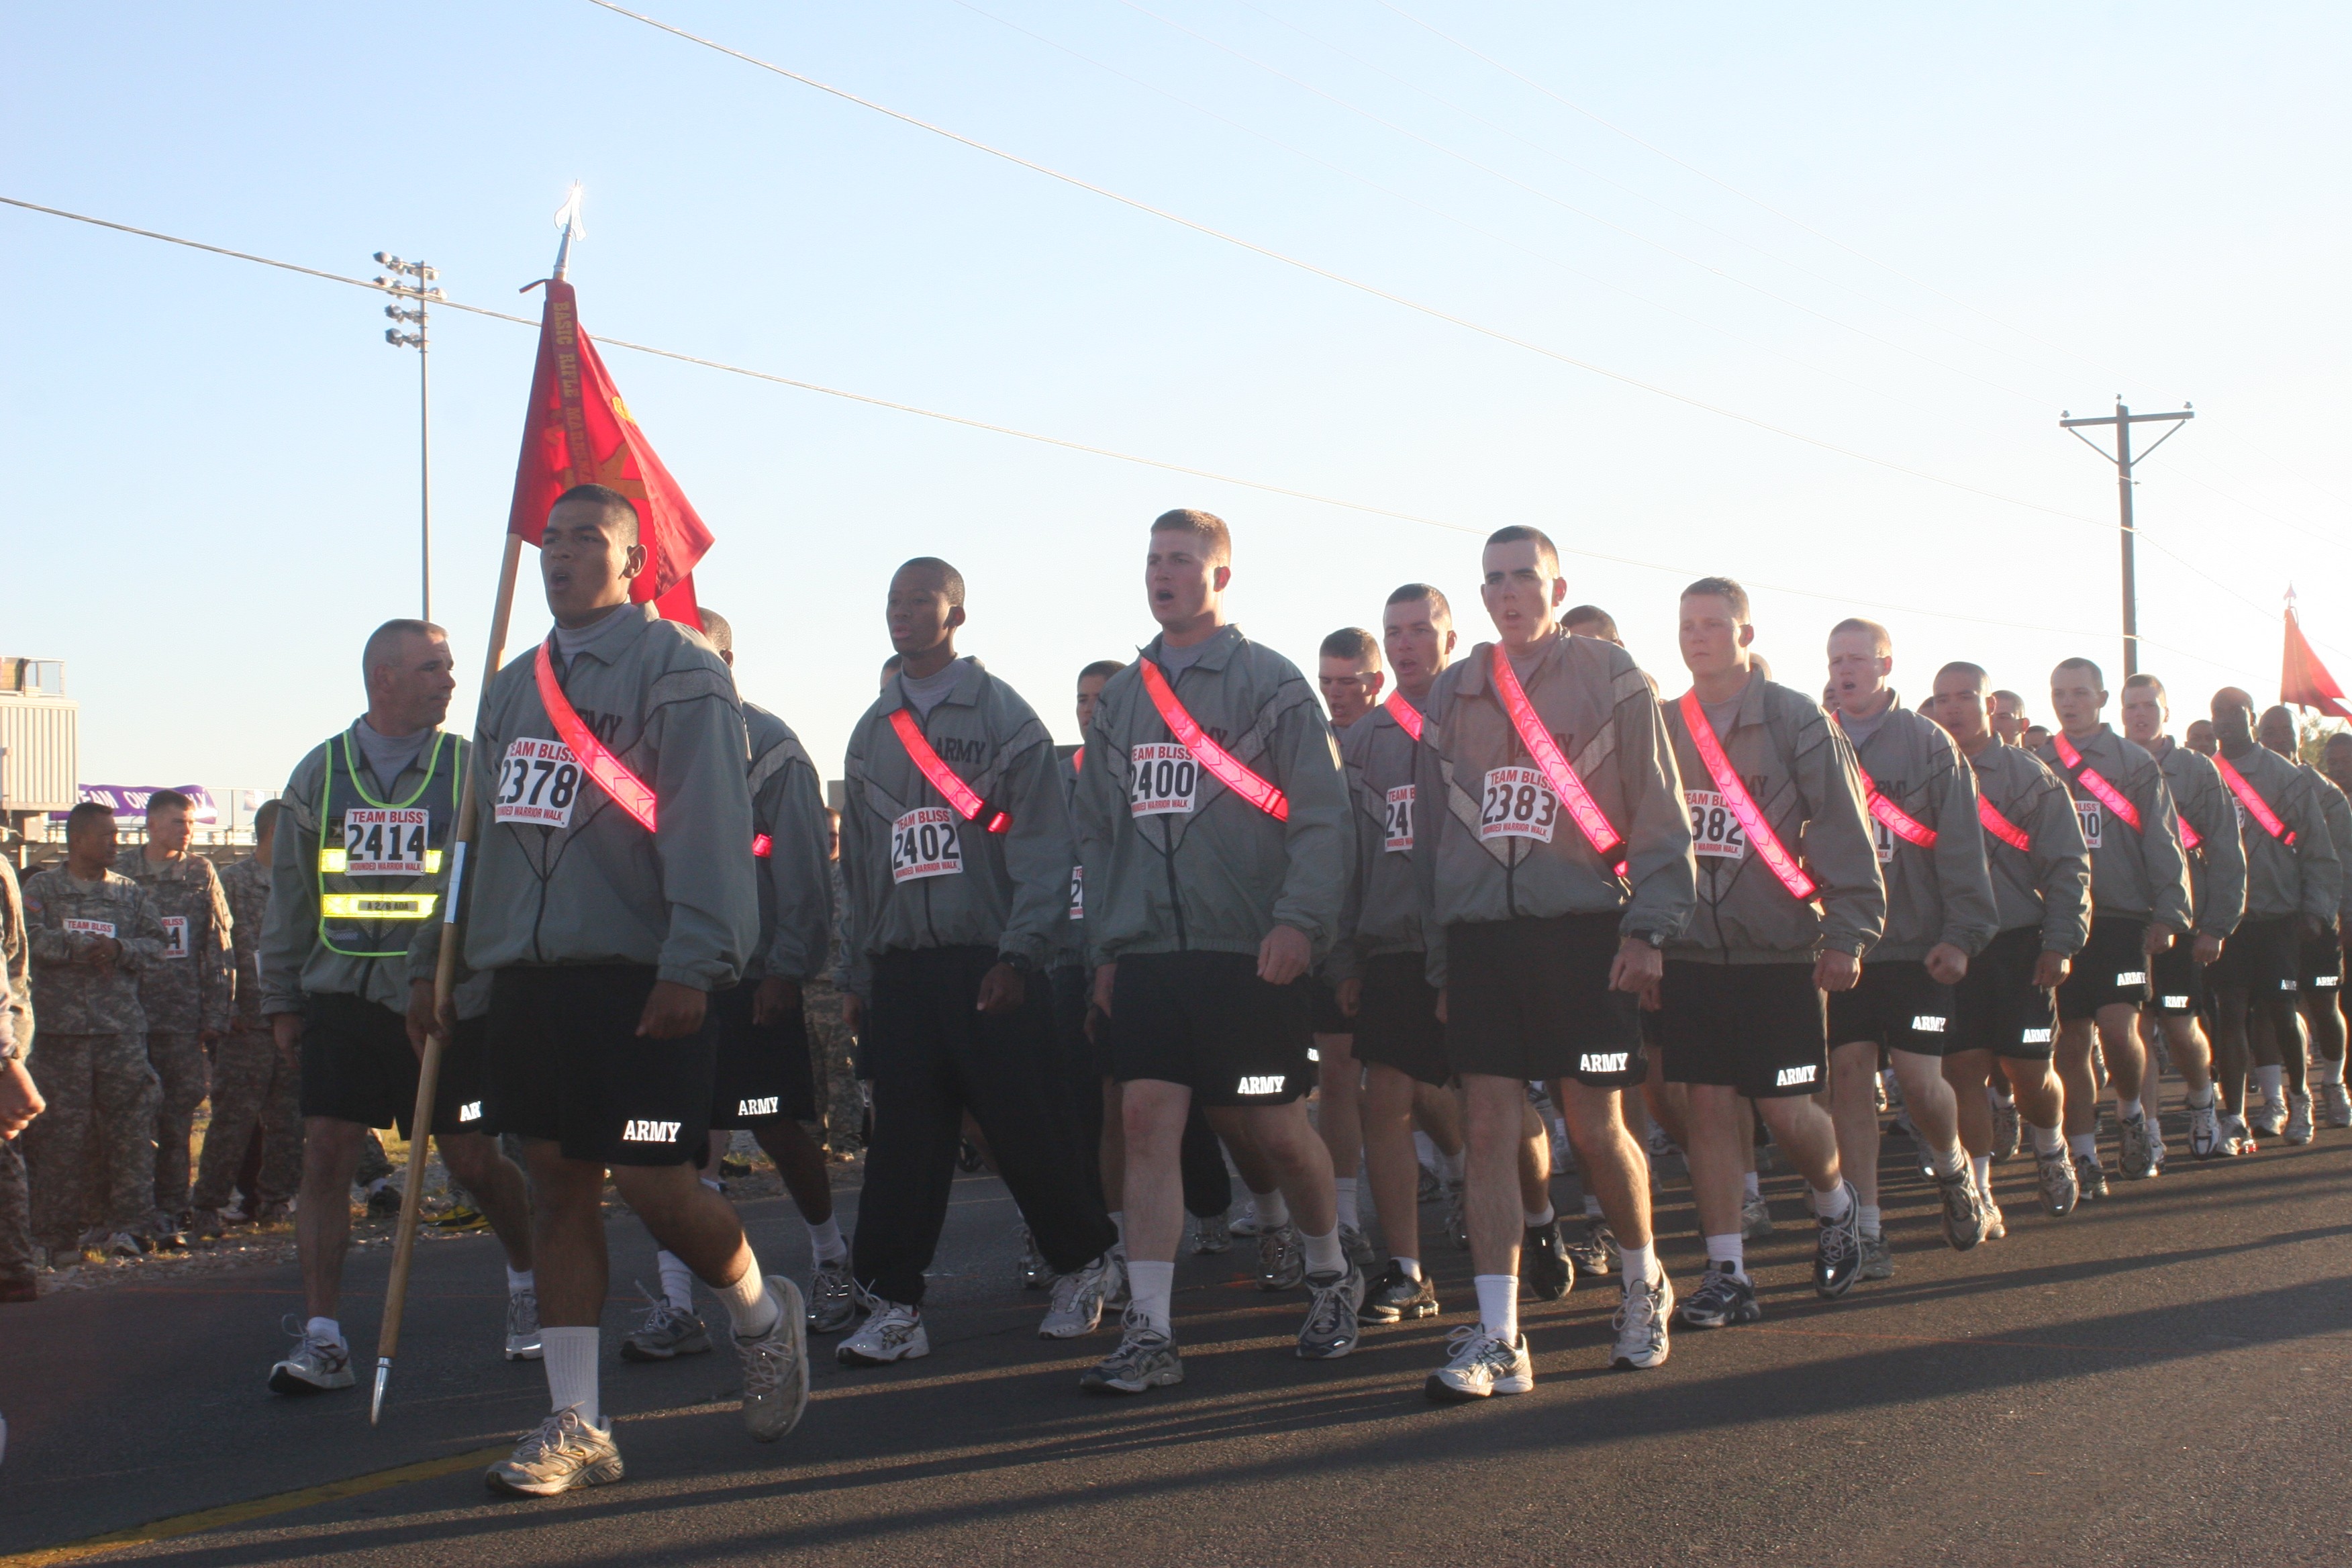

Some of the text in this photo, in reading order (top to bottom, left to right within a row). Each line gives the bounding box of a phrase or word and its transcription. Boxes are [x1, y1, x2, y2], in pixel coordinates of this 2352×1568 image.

[553, 300, 573, 345] BASIC
[558, 353, 579, 397] RIFLE
[509, 741, 536, 757] EAM
[1132, 746, 1155, 762] EAM
[497, 758, 579, 809] 2378
[1491, 770, 1518, 786] TEAM
[1172, 799, 1188, 808] WALK
[1389, 789, 1408, 803] TEAM
[1482, 784, 1557, 826] 2383
[352, 811, 424, 824] TEAM BLISS
[543, 809, 563, 822] WALK
[896, 810, 950, 832] TEAM BLISS
[1386, 801, 1414, 838] 24
[1531, 825, 1548, 837] WALK
[1690, 806, 1743, 846] 382
[347, 824, 426, 861] 2414
[893, 823, 960, 870] 2402
[378, 862, 403, 871] WARRIOR
[405, 863, 421, 871] WALK
[68, 920, 112, 932] TEAM BLISS
[2117, 972, 2147, 986] ARMY
[1912, 1016, 1947, 1032] ARMY
[2022, 1028, 2051, 1043] ARMY
[1579, 1052, 1628, 1073] ARMY
[1237, 1075, 1285, 1095] ARMY
[1776, 1065, 1816, 1087] ARMY
[459, 1101, 481, 1122] AR
[738, 1096, 779, 1116] ARMY
[623, 1120, 681, 1143] ARMY
